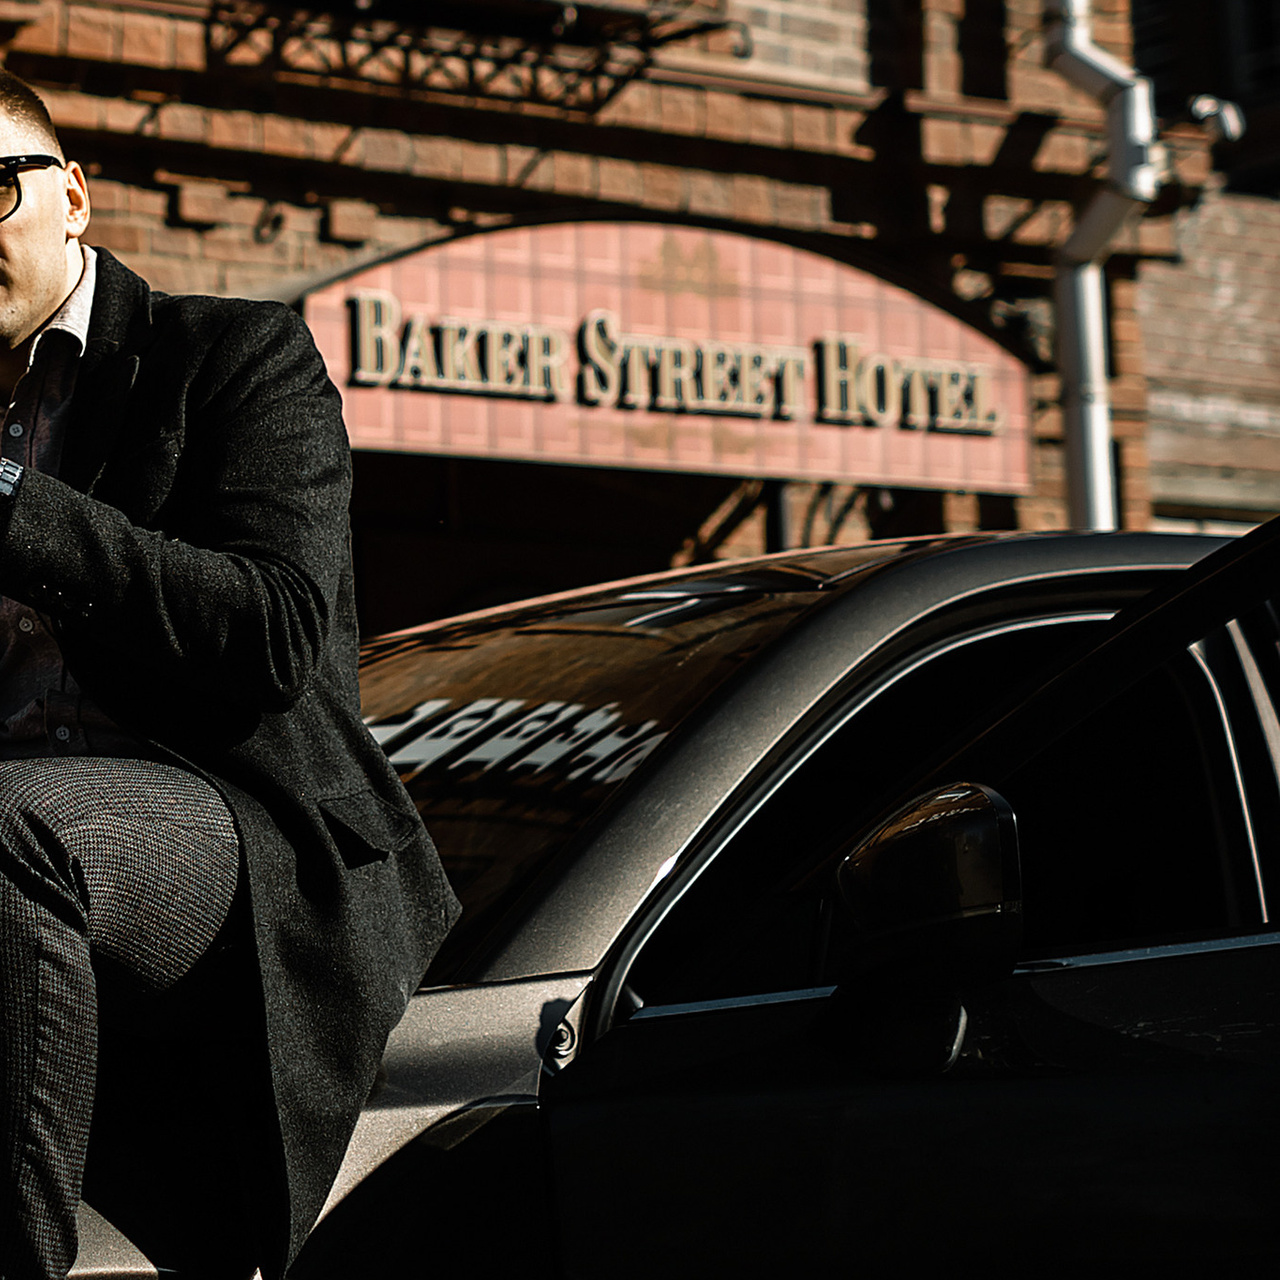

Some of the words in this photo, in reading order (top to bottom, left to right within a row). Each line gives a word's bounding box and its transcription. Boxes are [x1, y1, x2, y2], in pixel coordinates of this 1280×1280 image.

[346, 287, 570, 404] BAKER
[576, 308, 809, 421] STREET
[812, 332, 1006, 437] HOTEL
